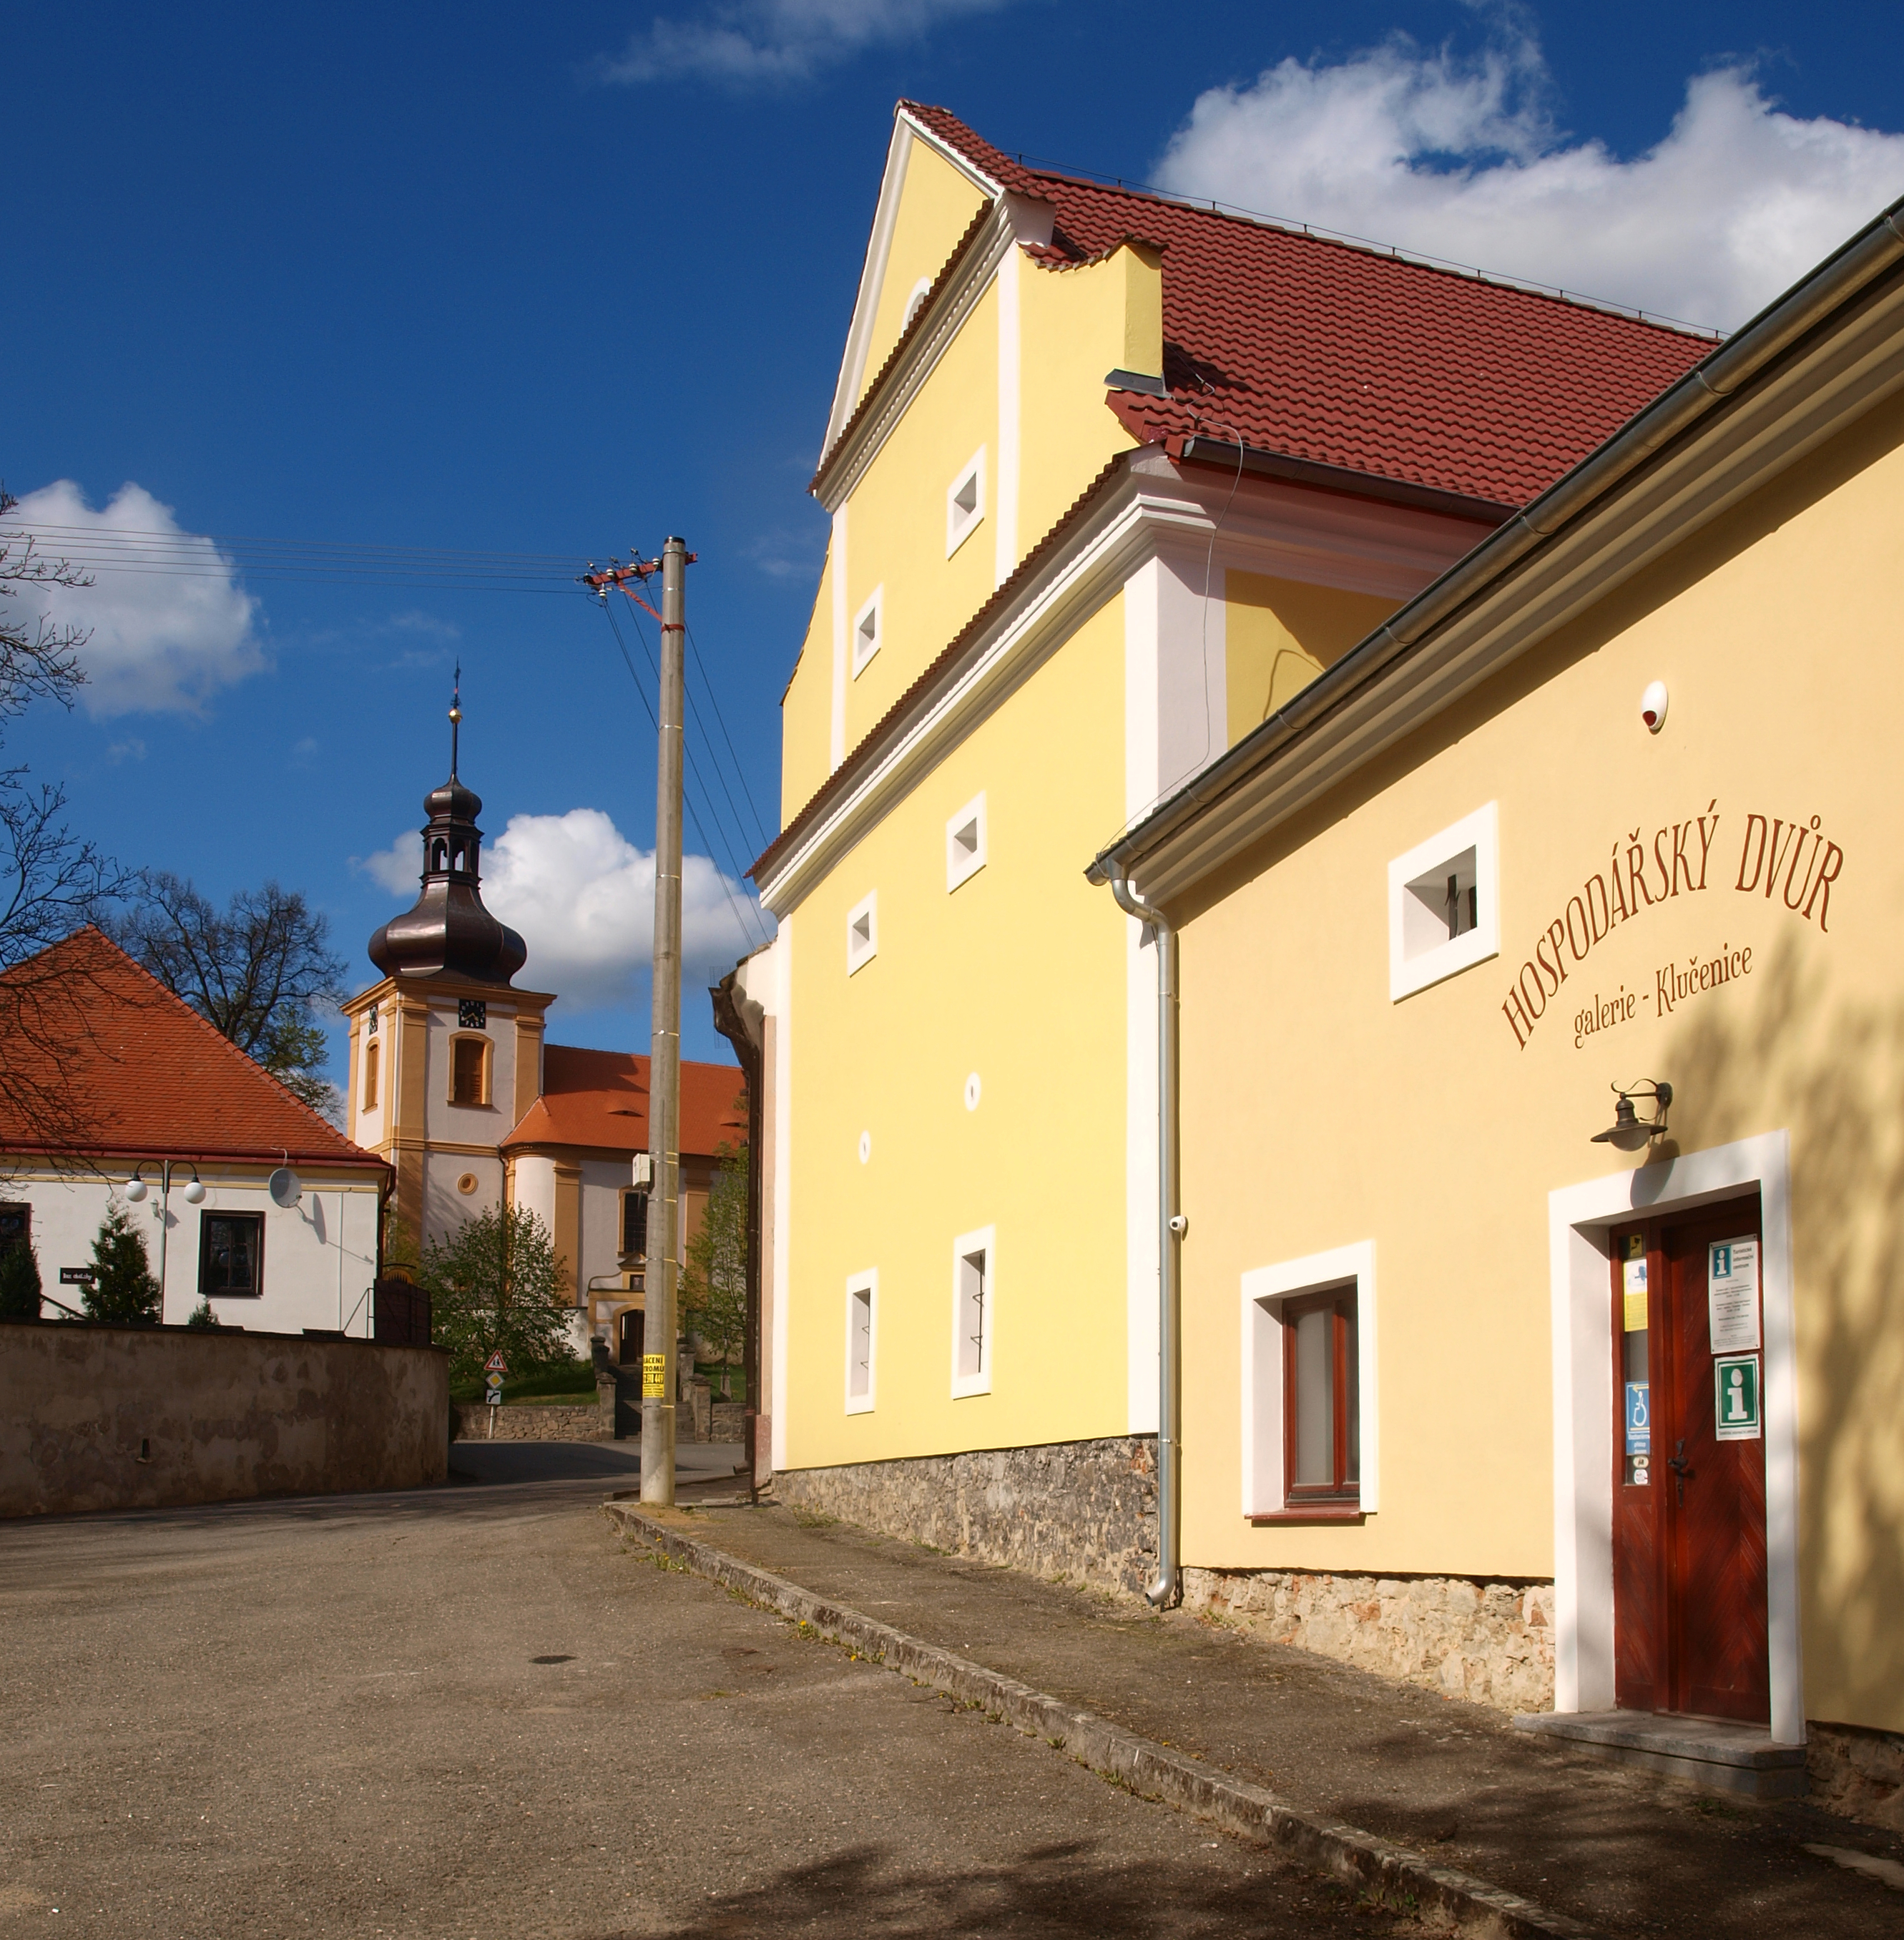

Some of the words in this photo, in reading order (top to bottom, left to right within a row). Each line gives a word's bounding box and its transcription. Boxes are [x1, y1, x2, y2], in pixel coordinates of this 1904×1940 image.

[1501, 798, 1719, 1051] HOSPODÁŘSKÝ
[1735, 813, 1844, 933] DVŮR
[1574, 985, 1636, 1049] galerie
[1656, 943, 1753, 1018] Klučenice
